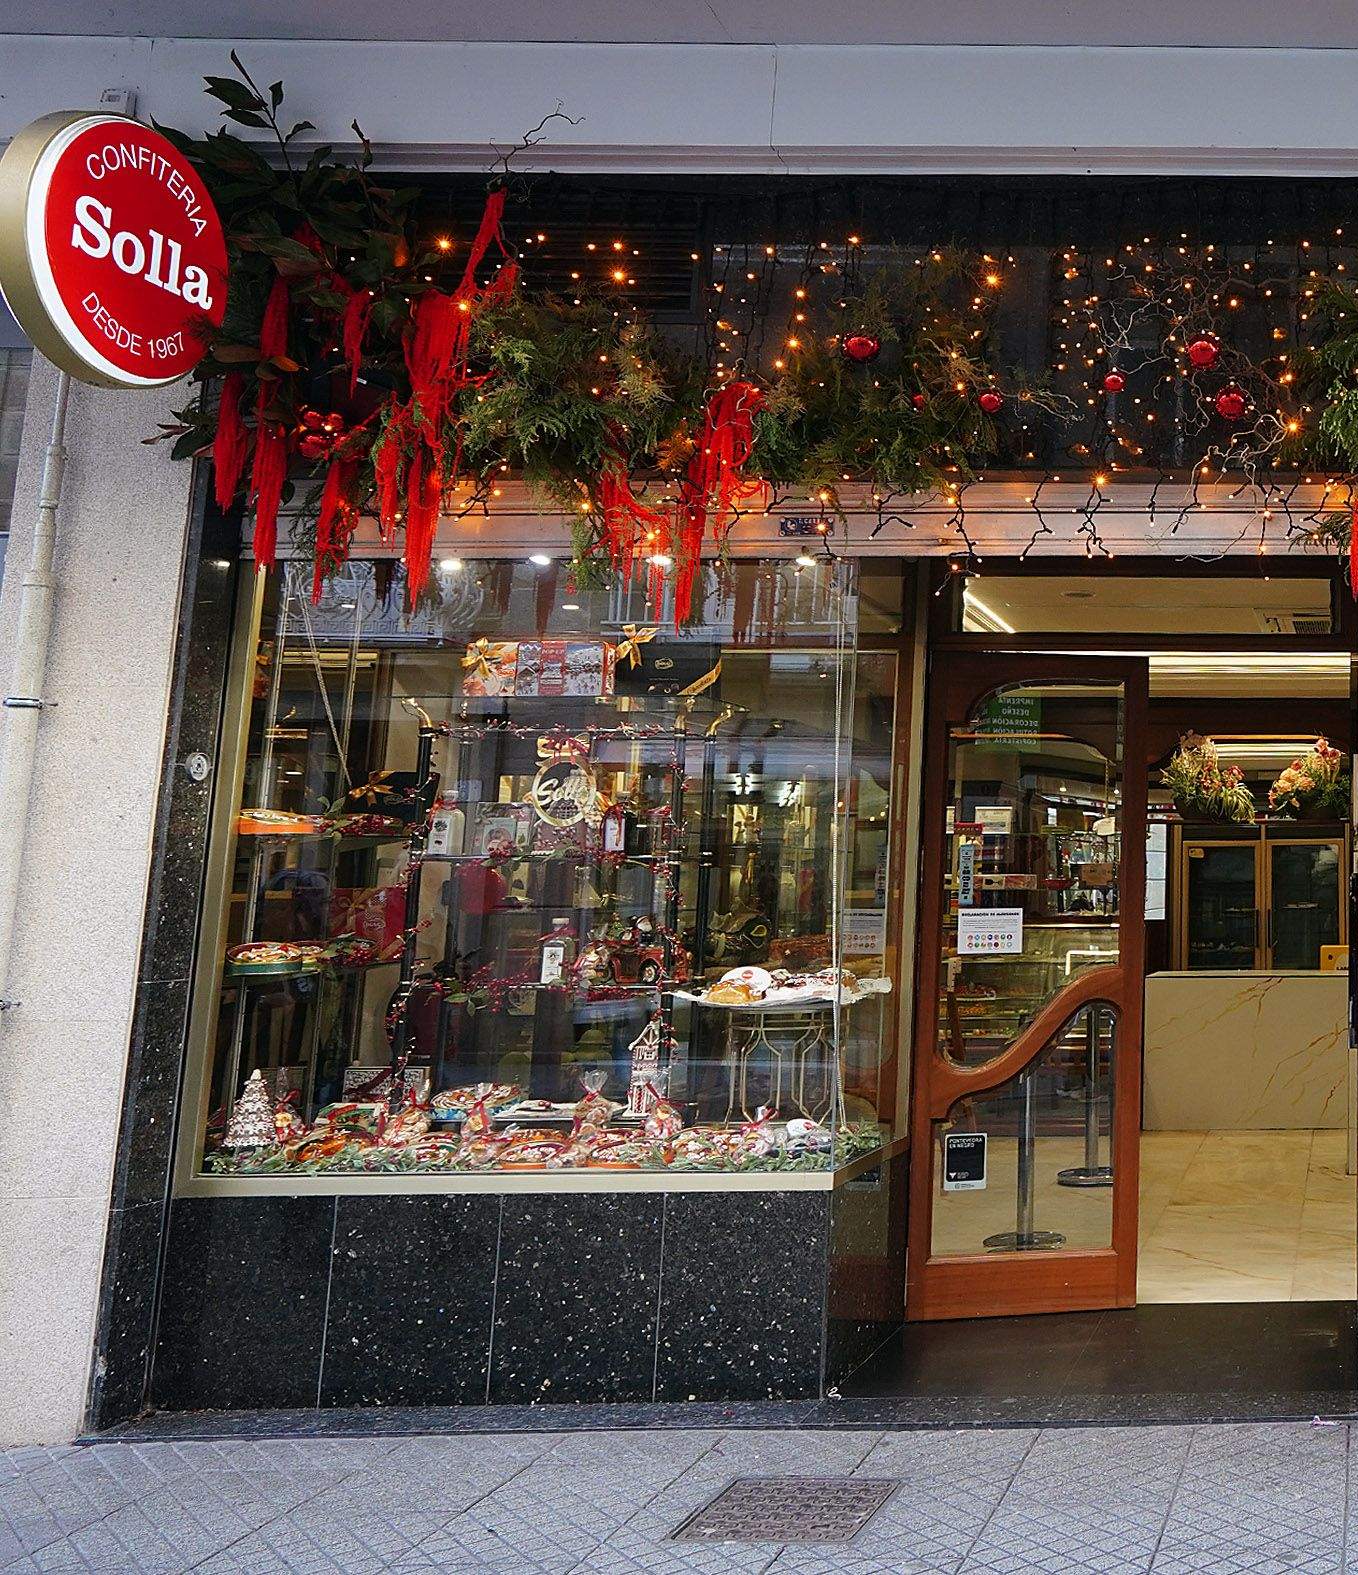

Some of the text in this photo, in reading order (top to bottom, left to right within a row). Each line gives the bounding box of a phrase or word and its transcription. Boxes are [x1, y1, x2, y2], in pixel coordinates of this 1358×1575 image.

[86, 143, 208, 237] CONFITERIA
[71, 195, 213, 310] Solla
[81, 291, 184, 359] DESDE 1967
